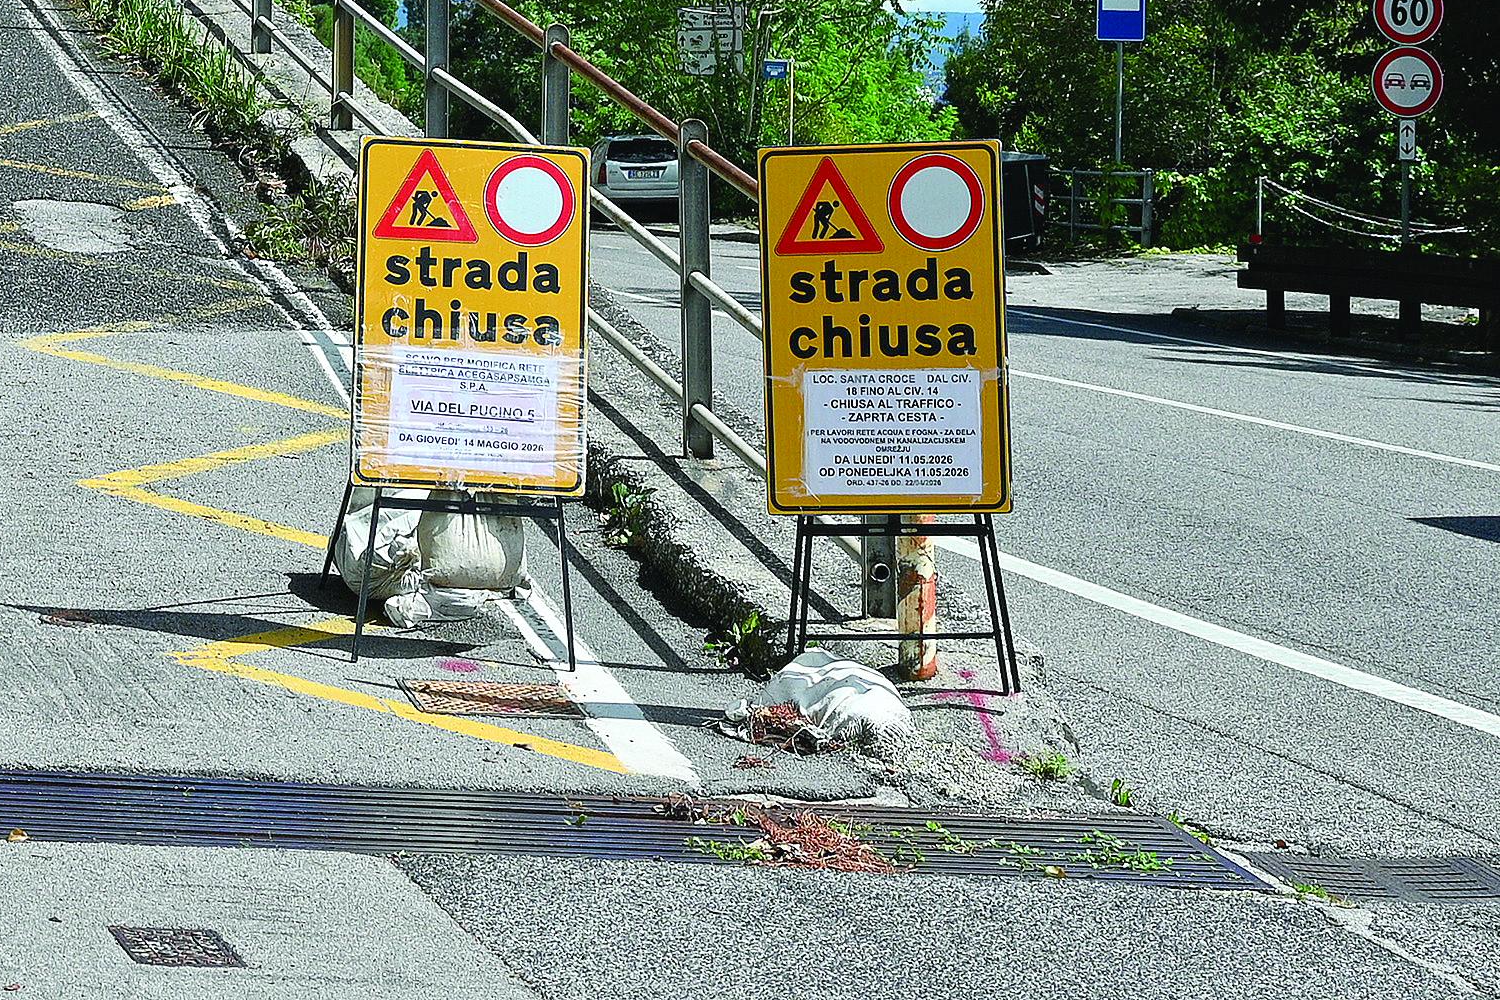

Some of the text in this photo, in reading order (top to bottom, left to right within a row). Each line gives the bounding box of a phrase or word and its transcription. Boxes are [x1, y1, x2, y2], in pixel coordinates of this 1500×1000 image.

[383, 246, 560, 294] strada
[789, 258, 974, 303] strada
[381, 299, 561, 346] chiusa
[789, 314, 977, 359] chiusa
[467, 357, 516, 370] MODIFICA
[518, 363, 546, 374] RETE
[813, 373, 972, 384] LOC. SANTA CROCE DAL CIV.
[459, 381, 489, 392] S.P.A.
[846, 386, 939, 396] 18 FINO AL CIV. 14
[411, 399, 535, 420] VIA DEL PUCINO 5
[830, 399, 875, 409] CHIUSA
[878, 399, 893, 408] AL
[896, 399, 954, 409] TRAFFICO
[848, 412, 895, 422] ZAPRTA
[898, 412, 937, 422] CESTA
[399, 433, 544, 452] DA GIOVEDI' 14 MAGGIO 2026
[834, 455, 953, 465] DA LUNEDI' 11.05.2026
[819, 467, 969, 477] OD PONEDELJKA 11.05.2026
